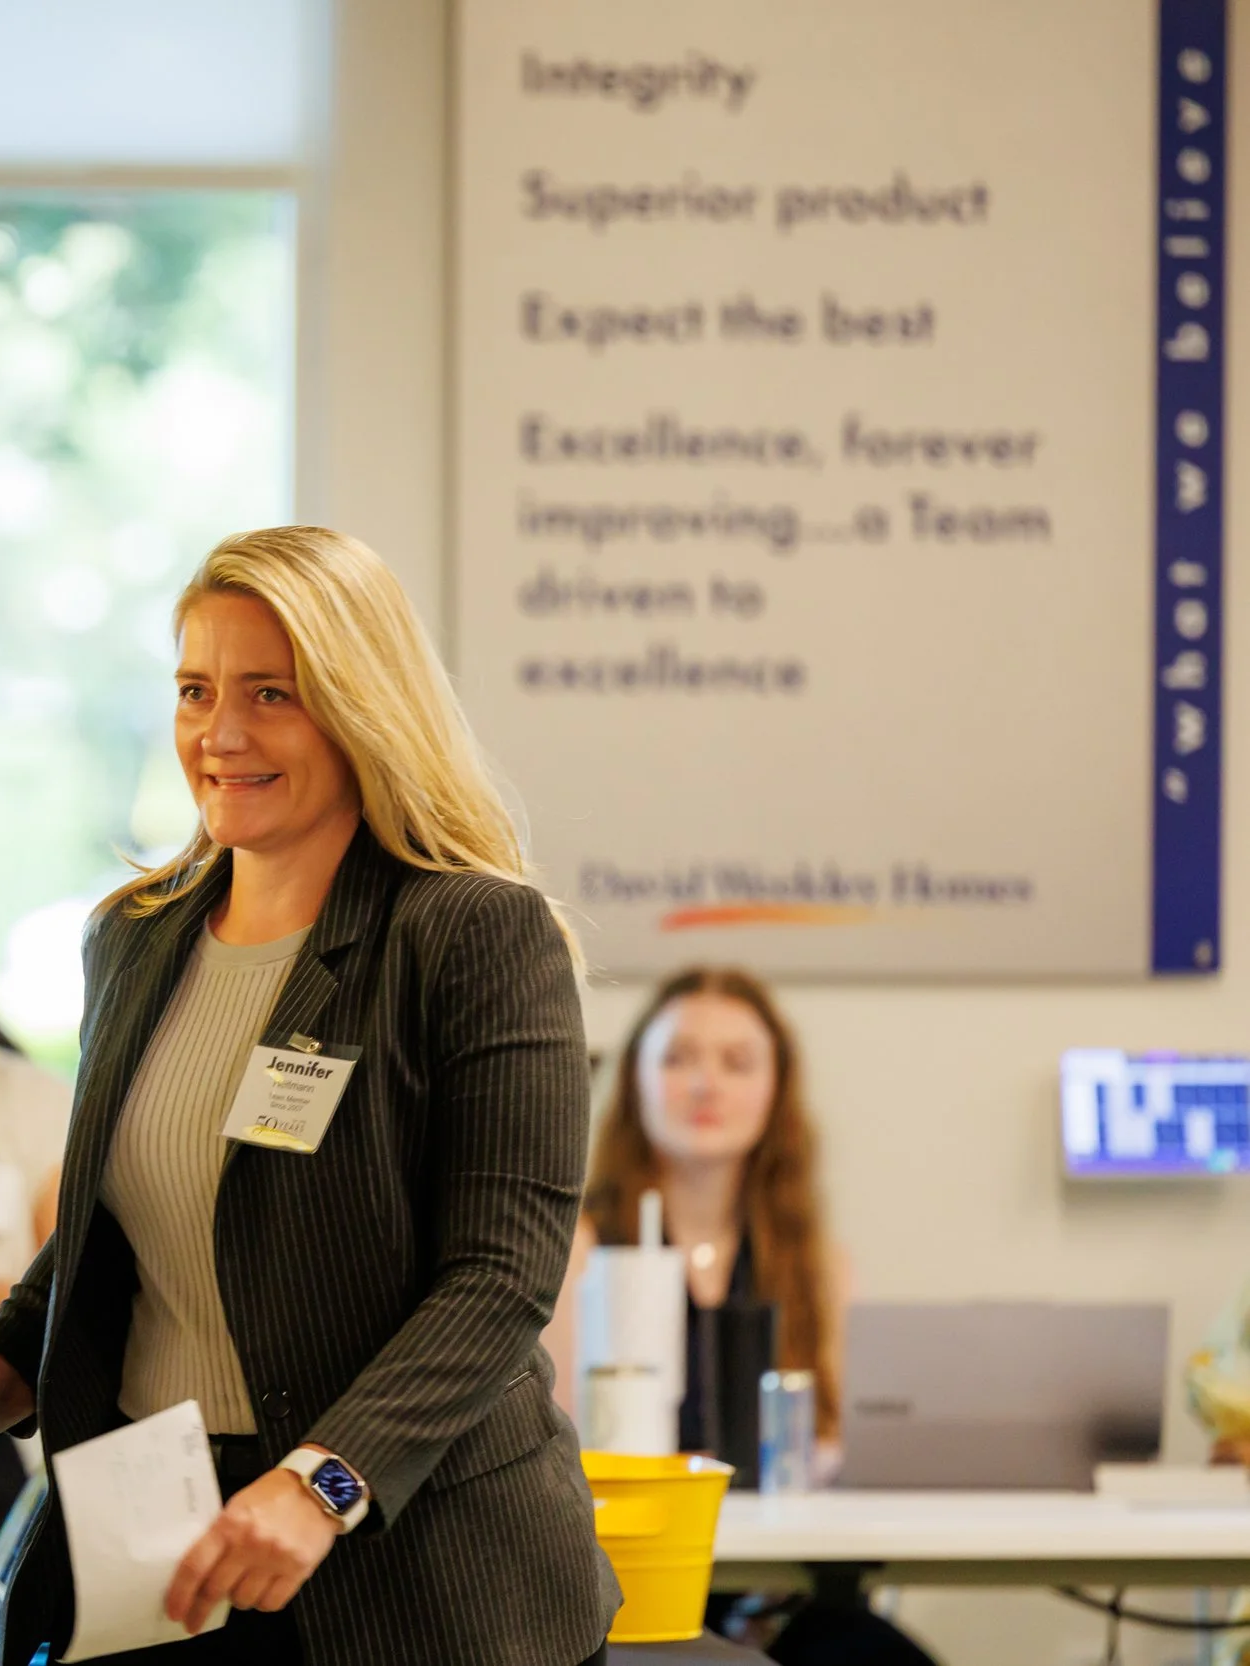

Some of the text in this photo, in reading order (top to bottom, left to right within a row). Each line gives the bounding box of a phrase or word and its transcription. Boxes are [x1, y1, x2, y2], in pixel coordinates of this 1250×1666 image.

[521, 51, 756, 113] Integrity
[520, 168, 991, 232] Superior product
[1164, 48, 1212, 362] believe
[519, 290, 937, 352] Expect the best
[519, 411, 1042, 470] Excellence, forever
[1174, 410, 1209, 512] we
[906, 492, 1053, 545] Team
[517, 566, 766, 620] driven to
[517, 644, 807, 694] excellence
[266, 1056, 333, 1079] Jennifer
